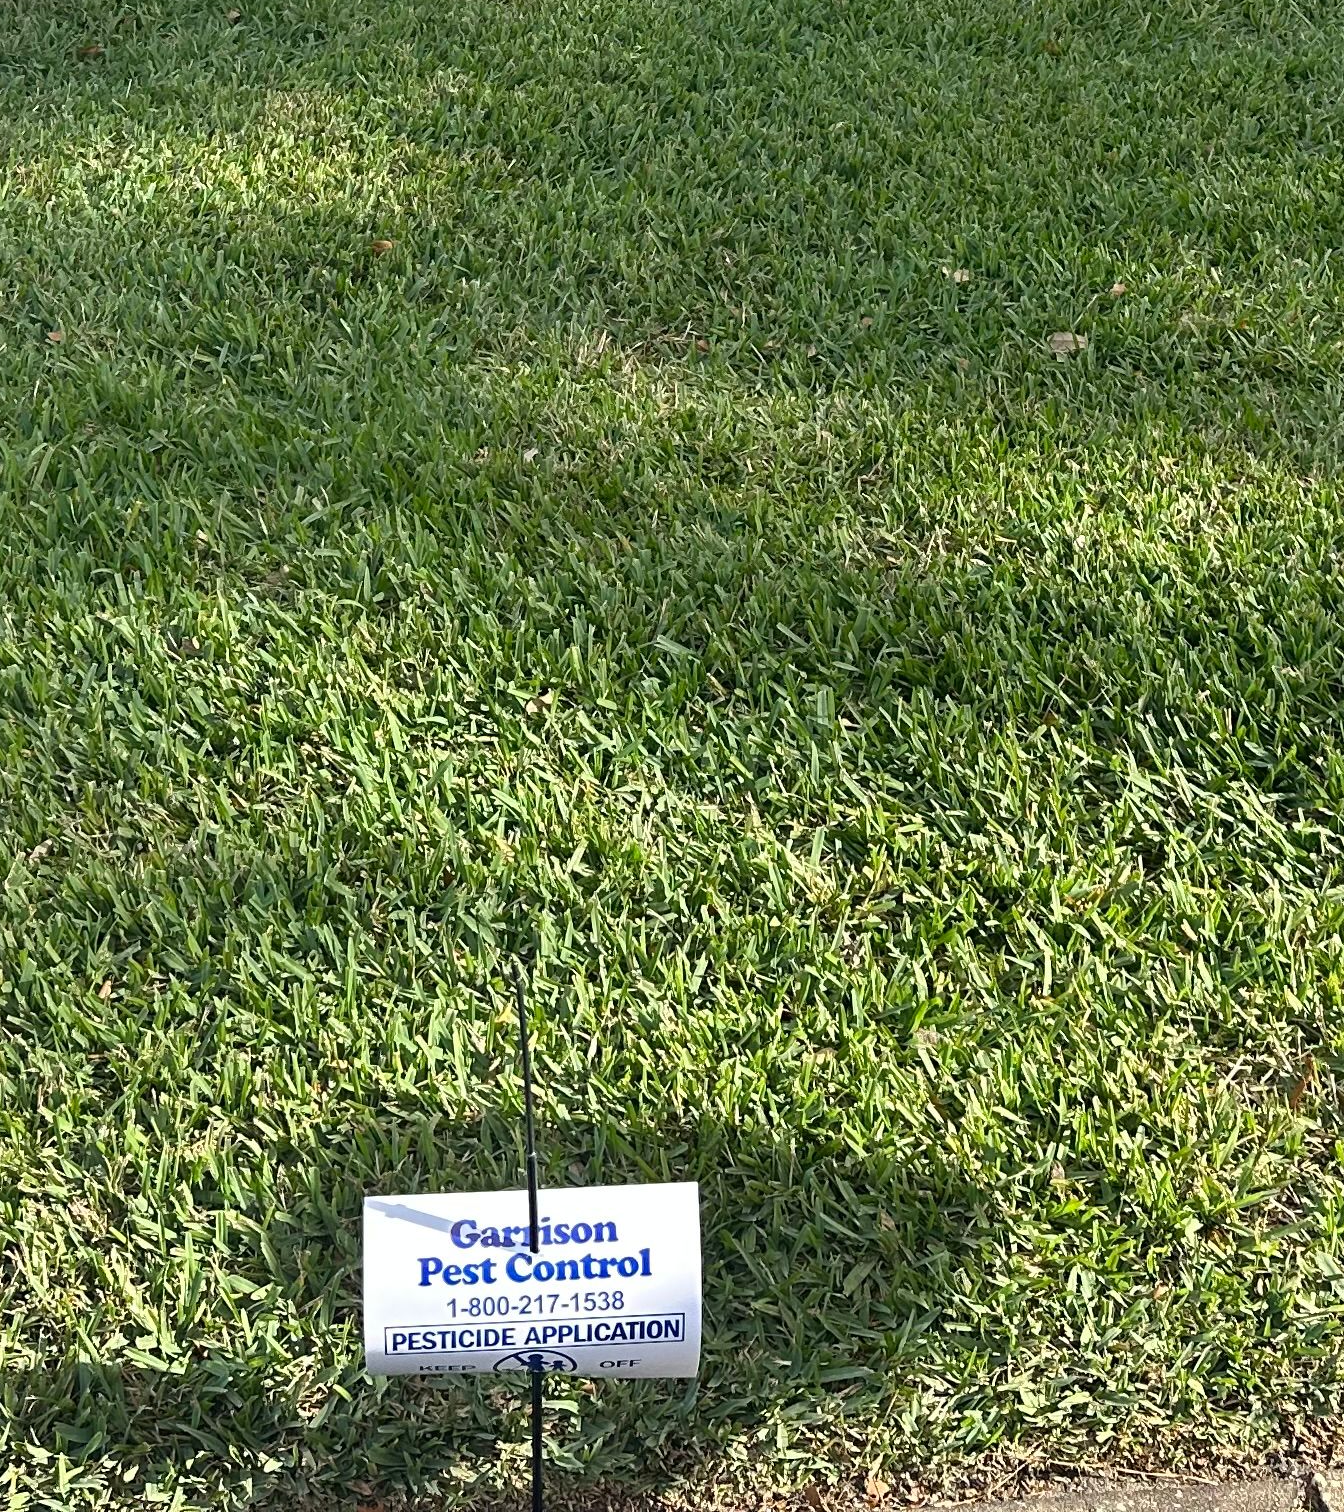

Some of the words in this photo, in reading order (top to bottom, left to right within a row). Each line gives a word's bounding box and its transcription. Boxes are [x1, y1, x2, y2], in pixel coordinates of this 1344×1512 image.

[418, 1256, 497, 1287] Pest
[506, 1248, 652, 1284] Control
[447, 1290, 625, 1319] 1-800-217-1538
[392, 1327, 515, 1352] PESTICIDE
[525, 1318, 680, 1345] APPLICATION
[419, 1364, 477, 1372] KEEP
[599, 1358, 642, 1369] OFF
